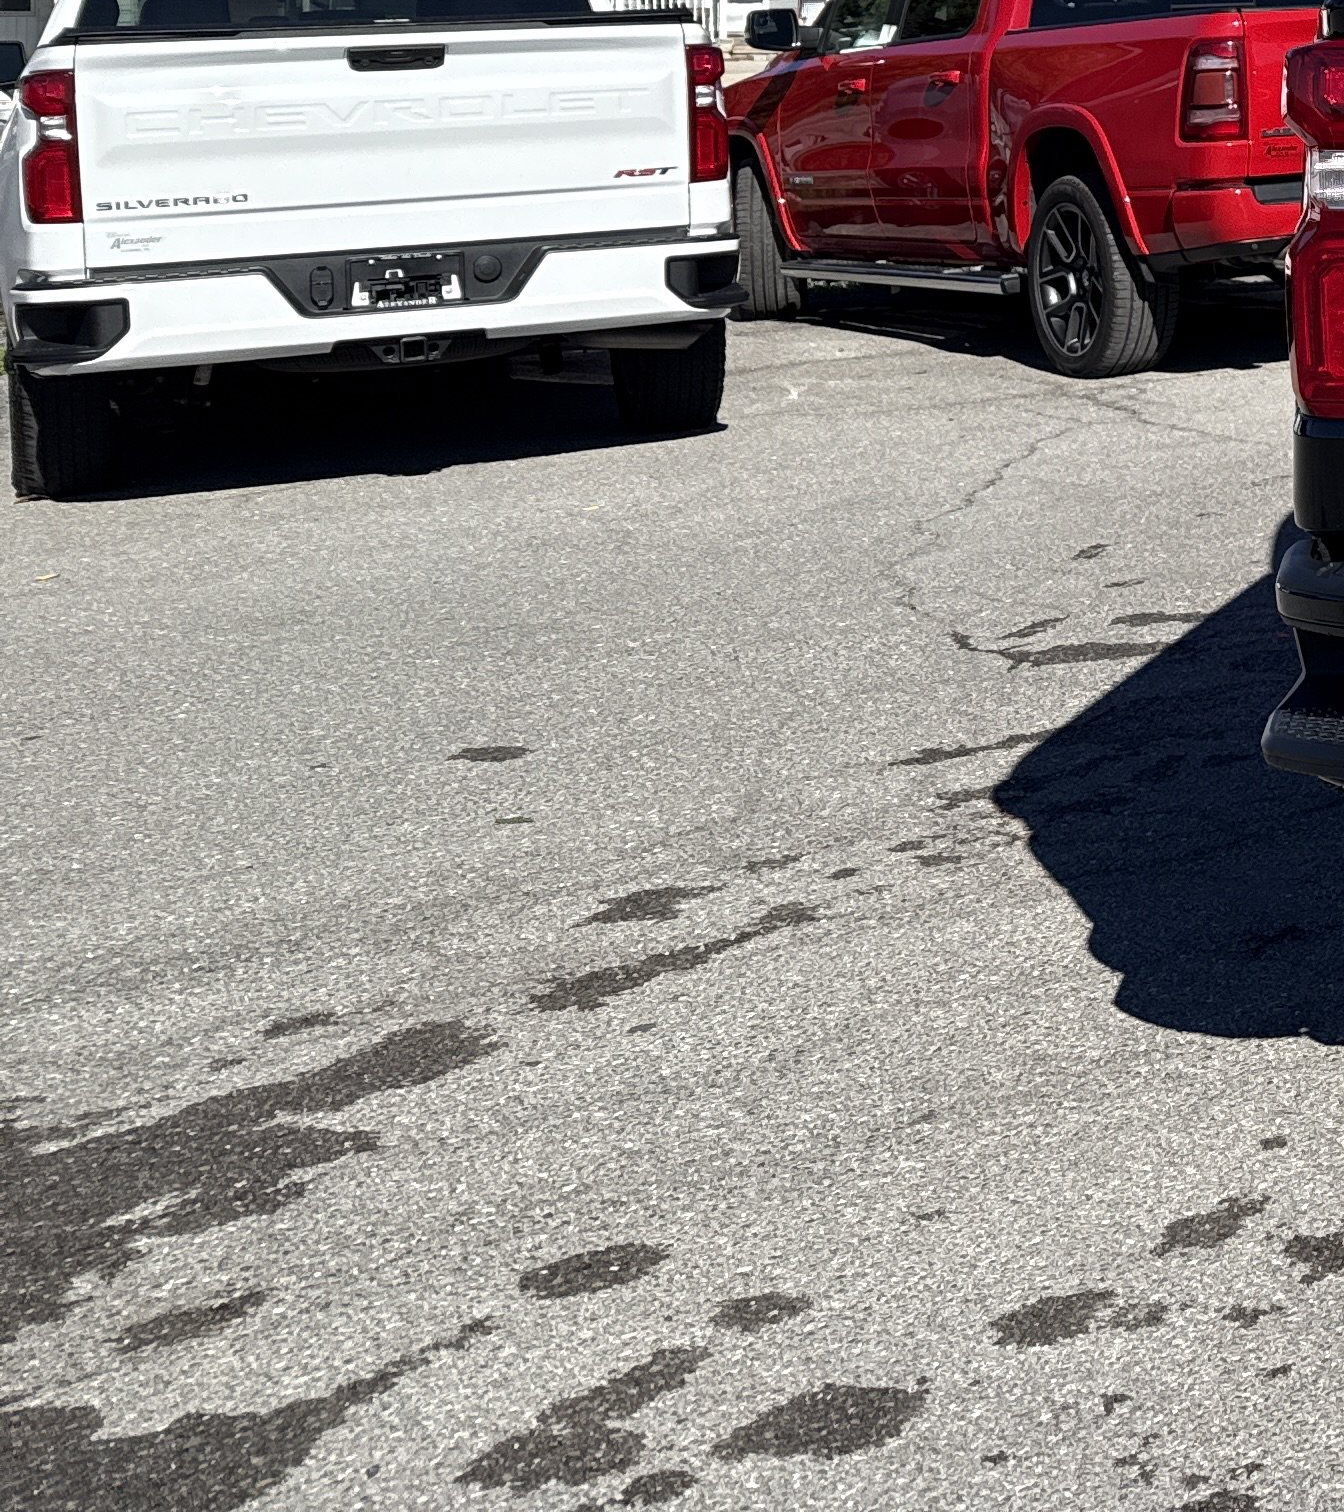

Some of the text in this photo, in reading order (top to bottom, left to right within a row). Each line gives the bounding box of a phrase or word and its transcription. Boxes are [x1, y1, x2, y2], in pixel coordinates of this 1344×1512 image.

[124, 87, 649, 140] CHEVROLET
[613, 166, 679, 179] RST
[96, 193, 248, 211] SILVERADO
